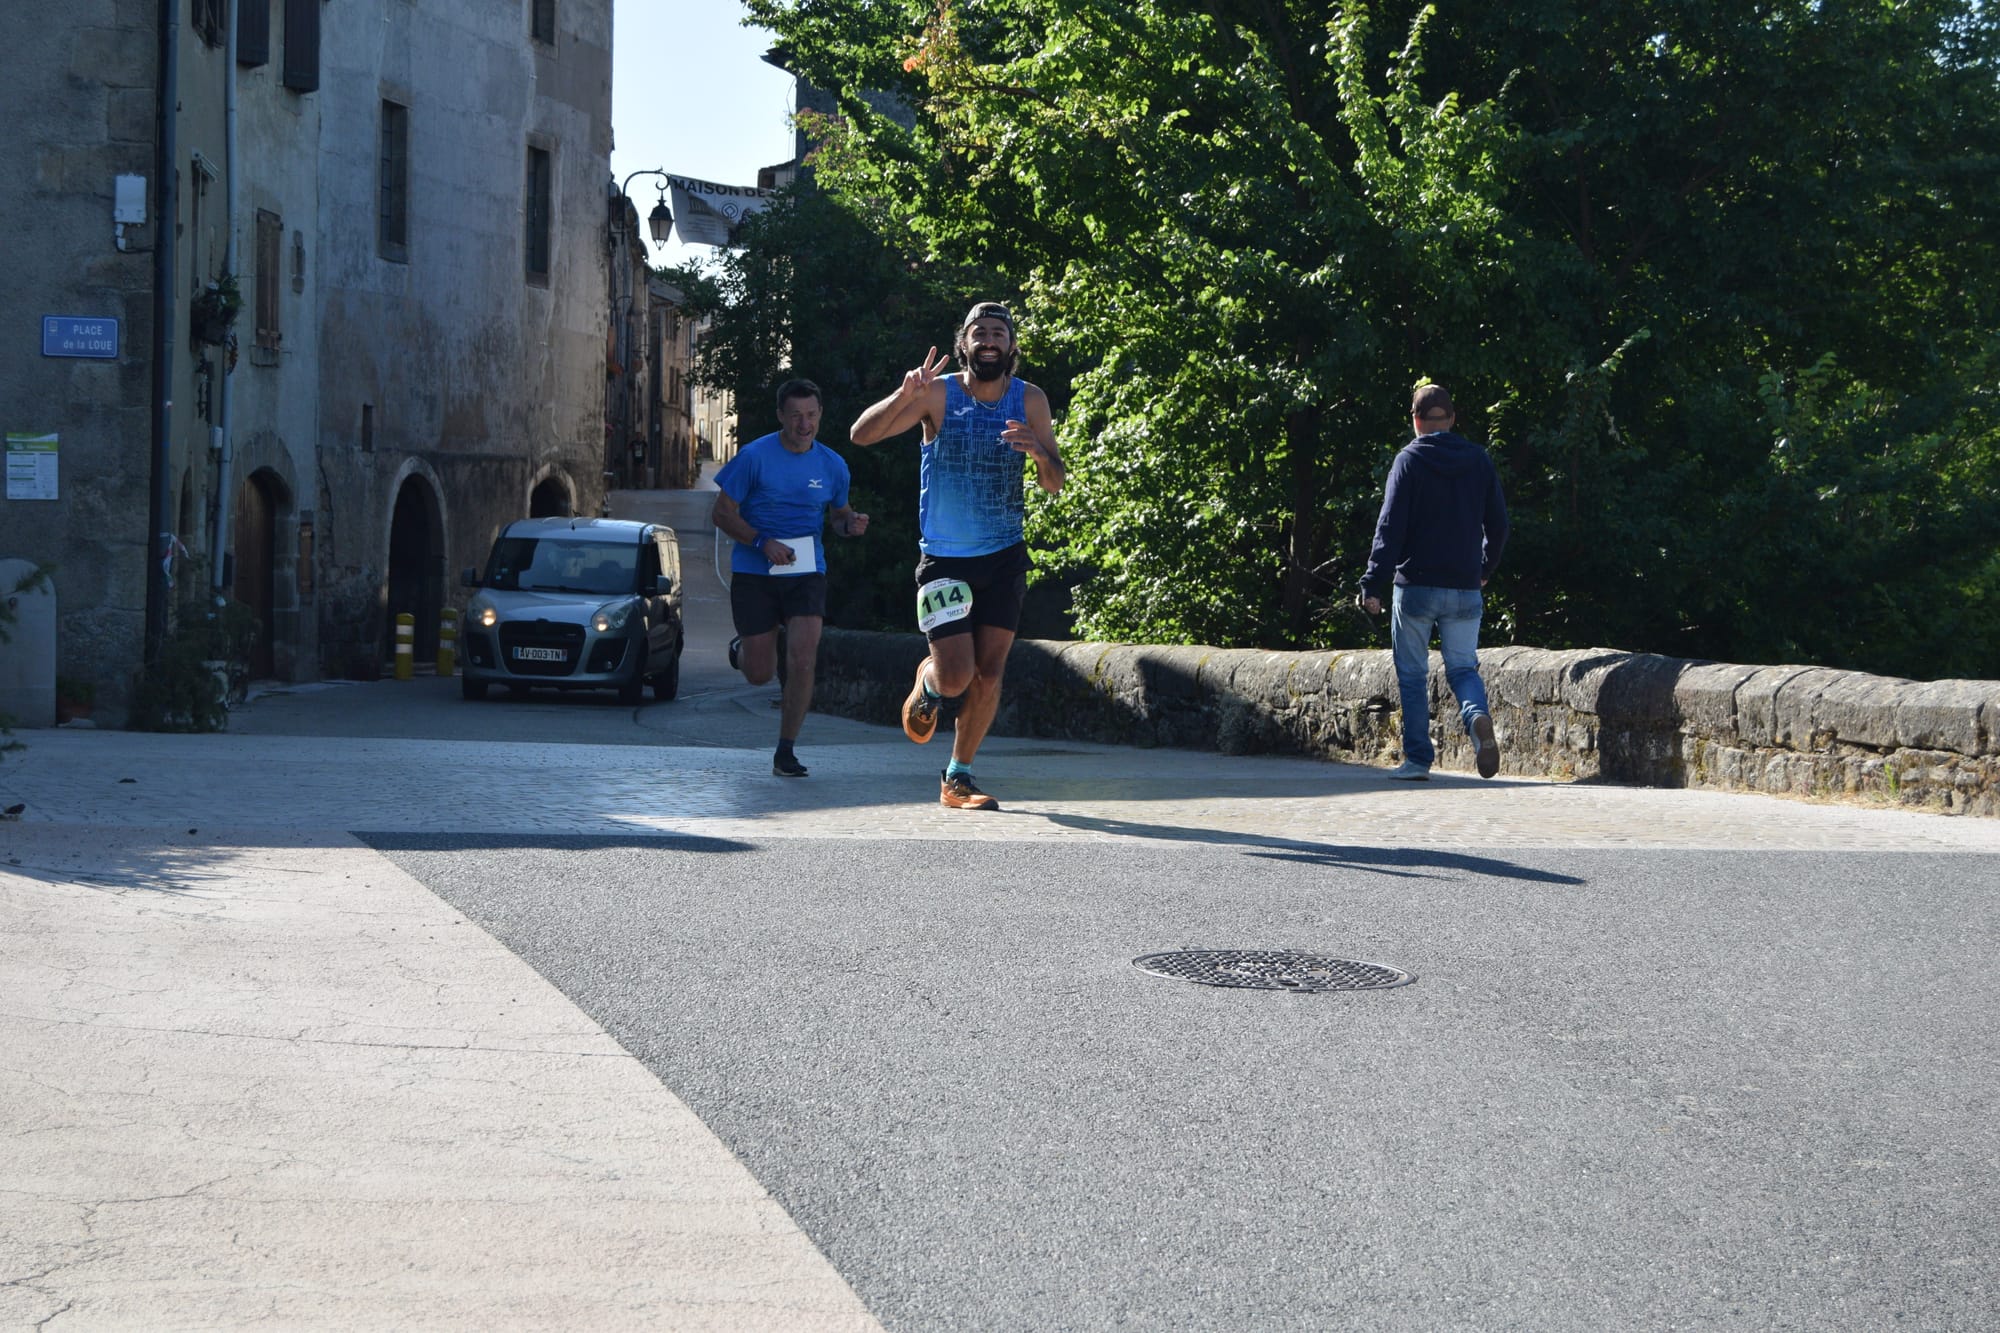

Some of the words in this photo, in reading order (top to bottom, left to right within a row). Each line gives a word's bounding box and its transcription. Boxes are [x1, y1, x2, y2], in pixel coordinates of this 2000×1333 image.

[673, 179, 740, 197] MAISON
[73, 324, 103, 336] PLACE
[63, 340, 74, 350] de
[76, 340, 85, 350] la
[88, 340, 113, 351] LOUE
[922, 586, 964, 614] 114
